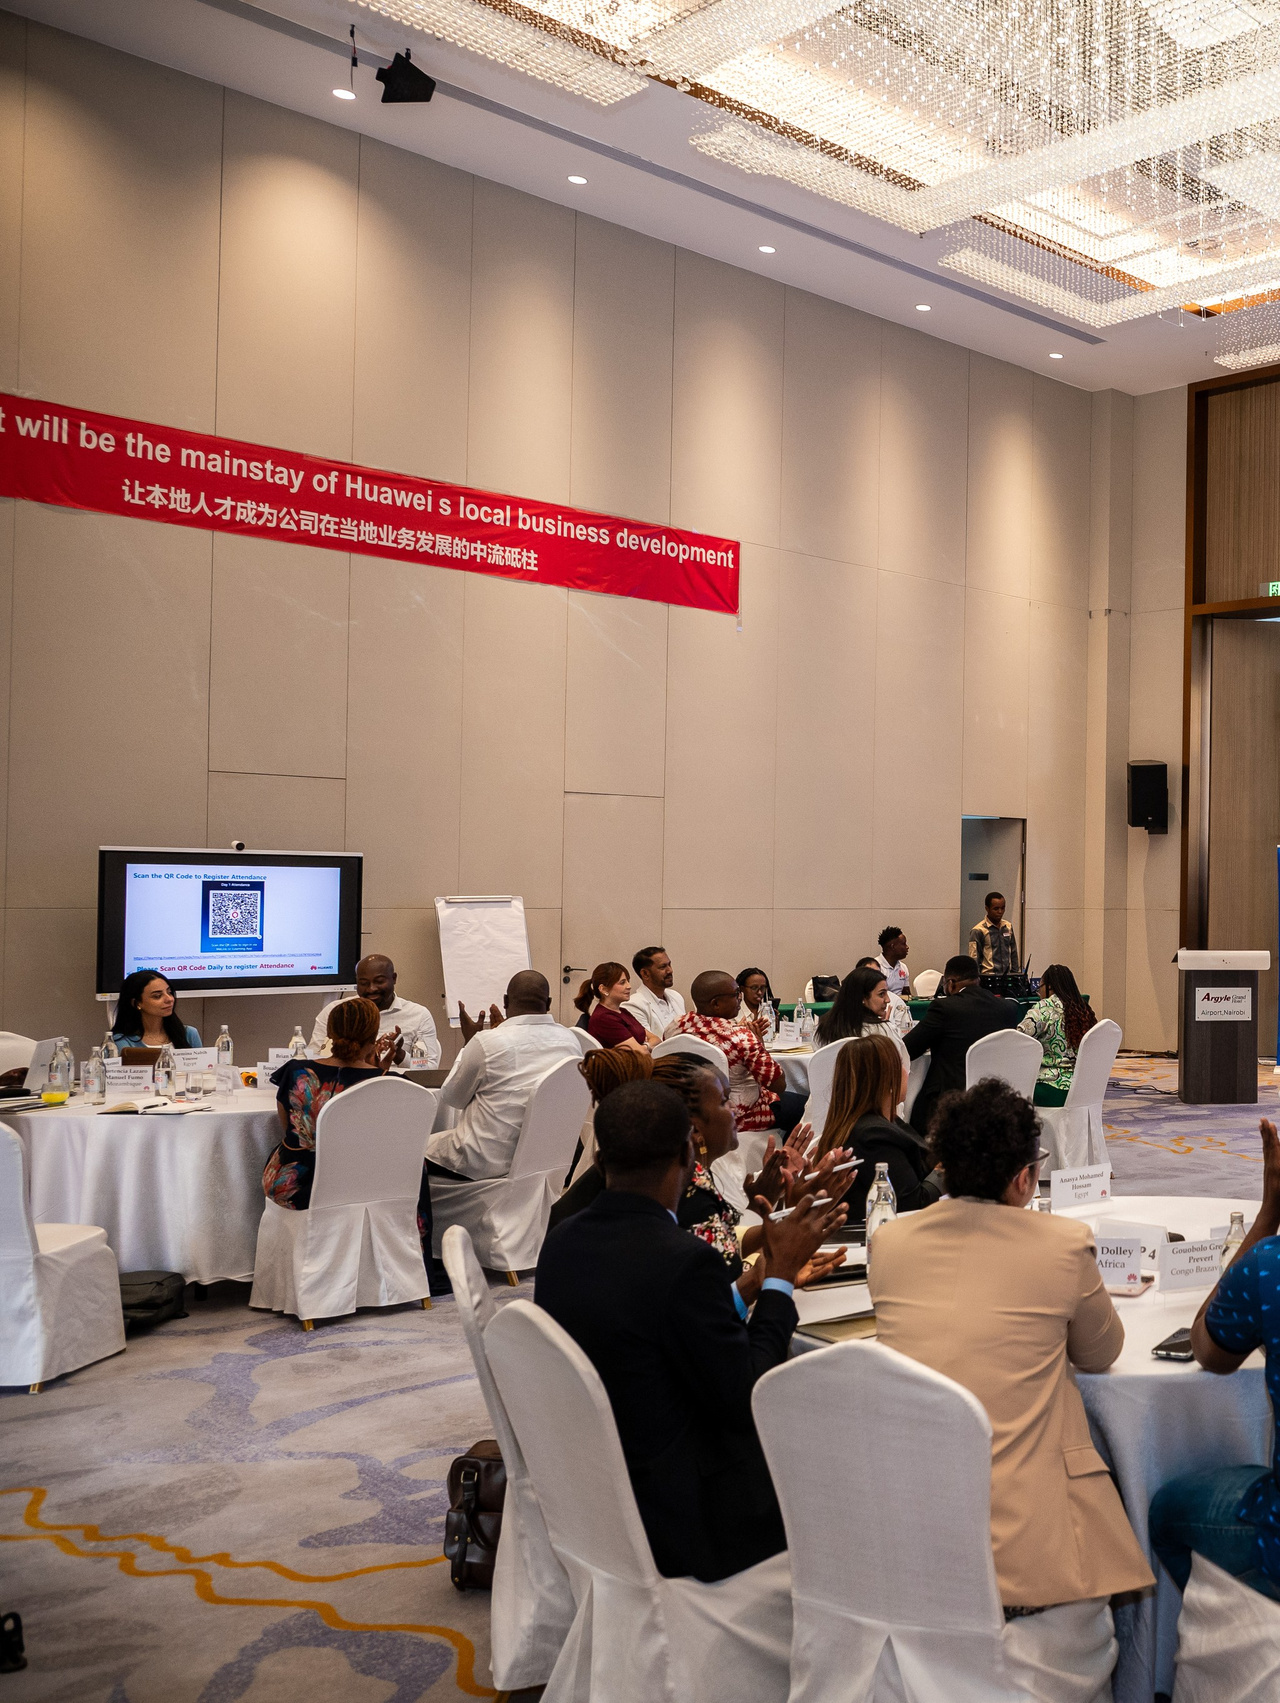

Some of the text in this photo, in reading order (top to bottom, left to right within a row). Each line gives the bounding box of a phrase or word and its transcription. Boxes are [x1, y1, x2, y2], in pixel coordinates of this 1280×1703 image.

[15, 414, 68, 444] will
[79, 421, 116, 453] be
[125, 432, 171, 463] the
[180, 446, 305, 493] mainstay
[312, 470, 338, 495] of
[346, 473, 432, 512] Huawei
[439, 498, 452, 516] s
[459, 496, 511, 527] local
[518, 508, 610, 545] business
[617, 528, 735, 569] development
[121, 479, 538, 571] 让本地人才成为公司在当地业务发展的中流砥柱
[203, 873, 229, 881] Register
[208, 964, 224, 972] Daily
[1201, 992, 1231, 1003] Argyle
[1079, 1171, 1104, 1180] Mohamed
[1074, 1191, 1089, 1199] Egypt
[1101, 1246, 1134, 1258] Dolley
[1148, 1249, 1156, 1260] 4
[1188, 1254, 1214, 1263] Prevert
[1098, 1259, 1125, 1268] Africa
[1170, 1267, 1194, 1276] Congo
